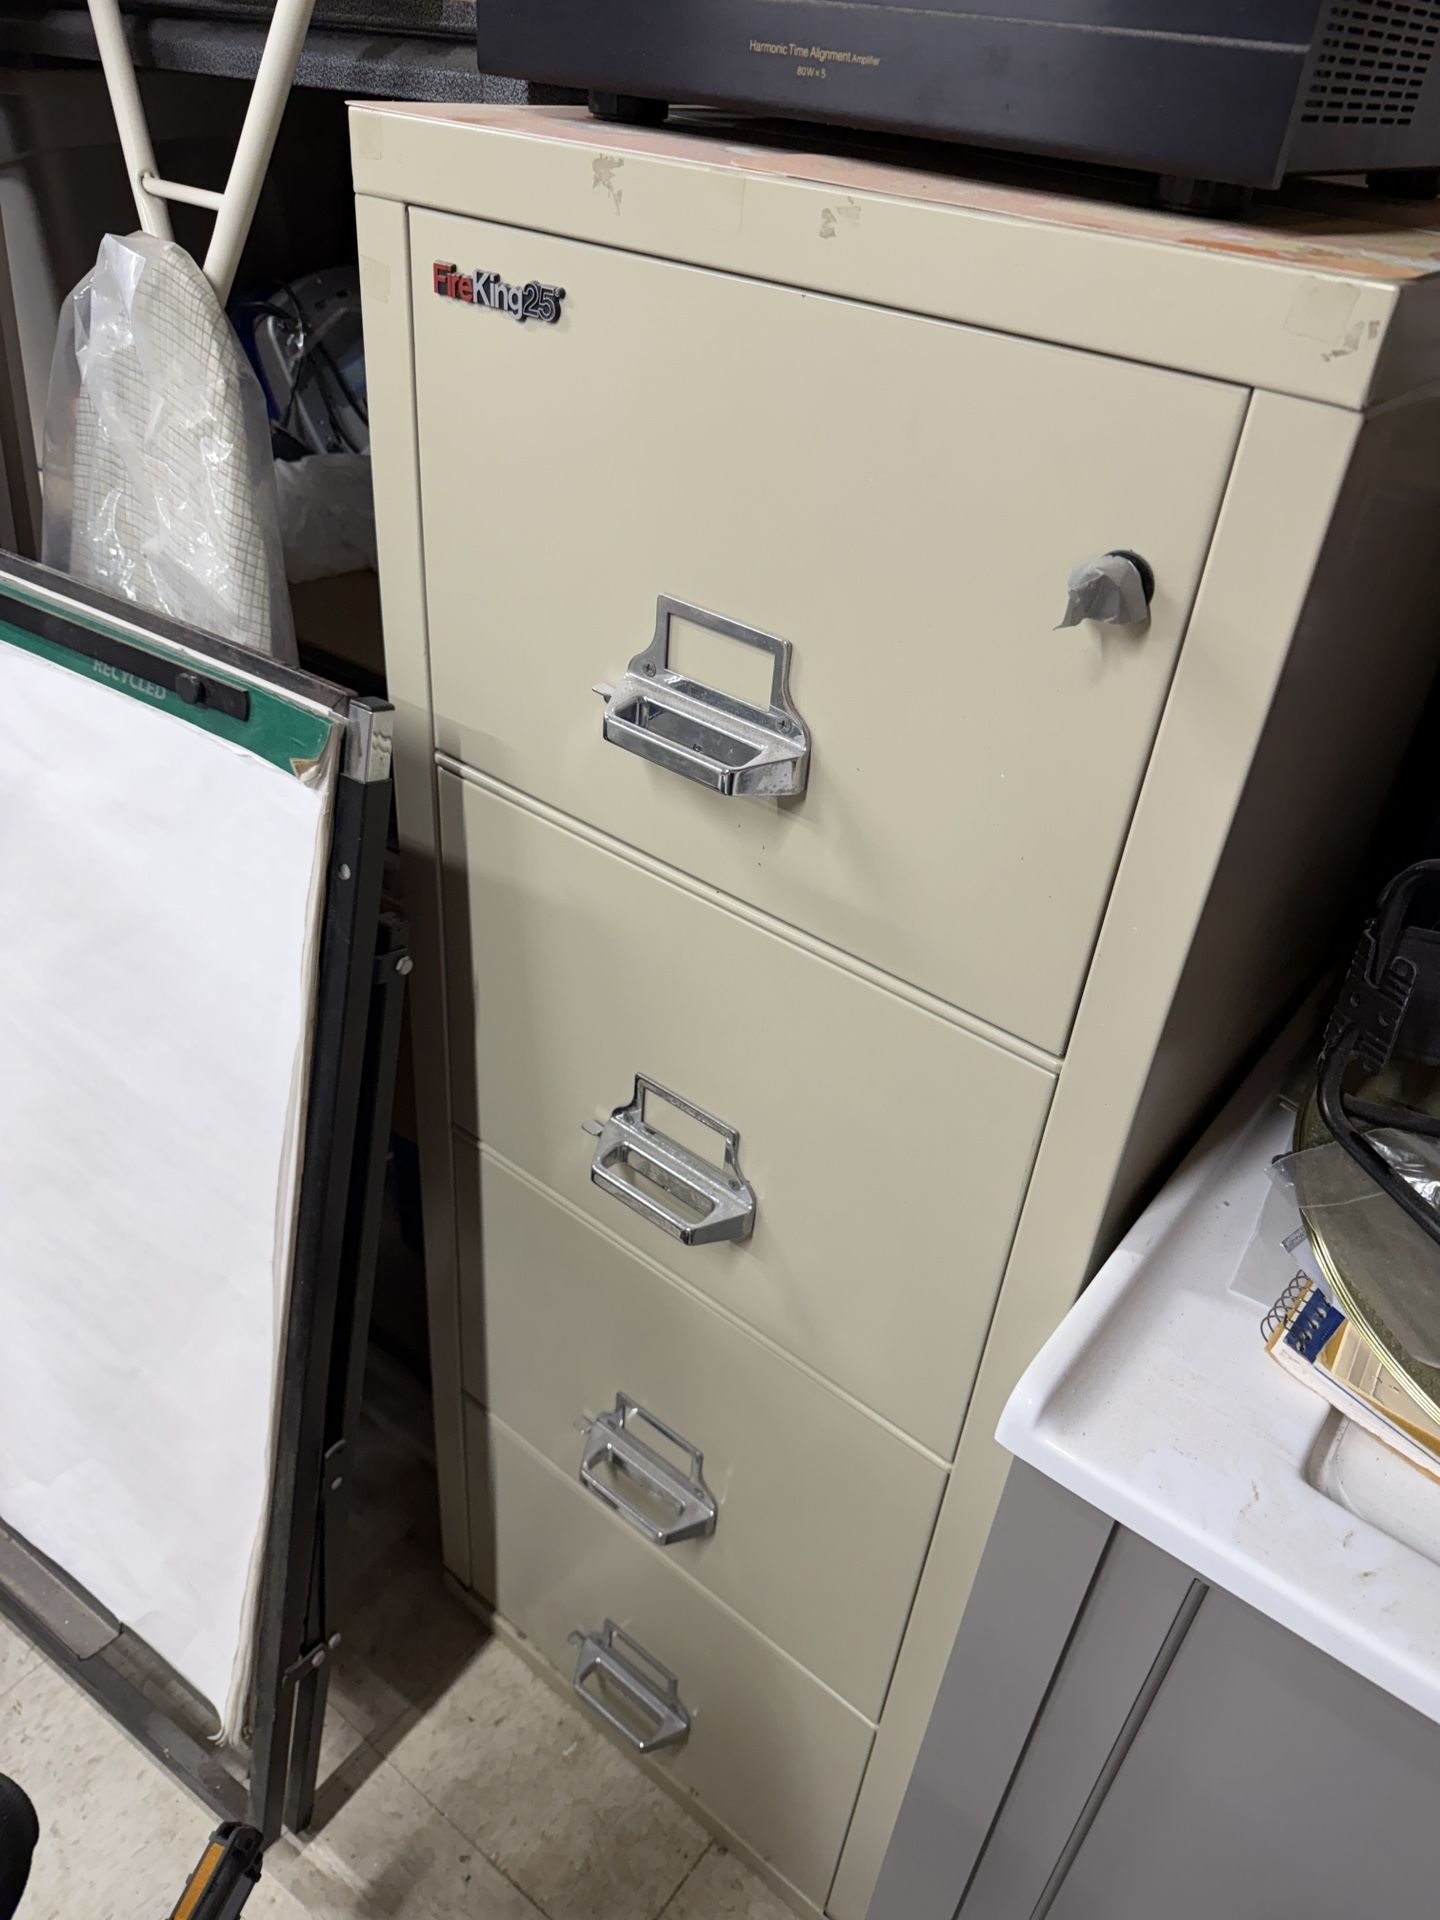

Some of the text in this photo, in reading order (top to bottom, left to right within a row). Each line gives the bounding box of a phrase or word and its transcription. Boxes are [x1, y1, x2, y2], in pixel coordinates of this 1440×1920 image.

[749, 40, 880, 65] Harmonic Time Alignment Amplifier
[93, 660, 167, 700] RECYCLED
